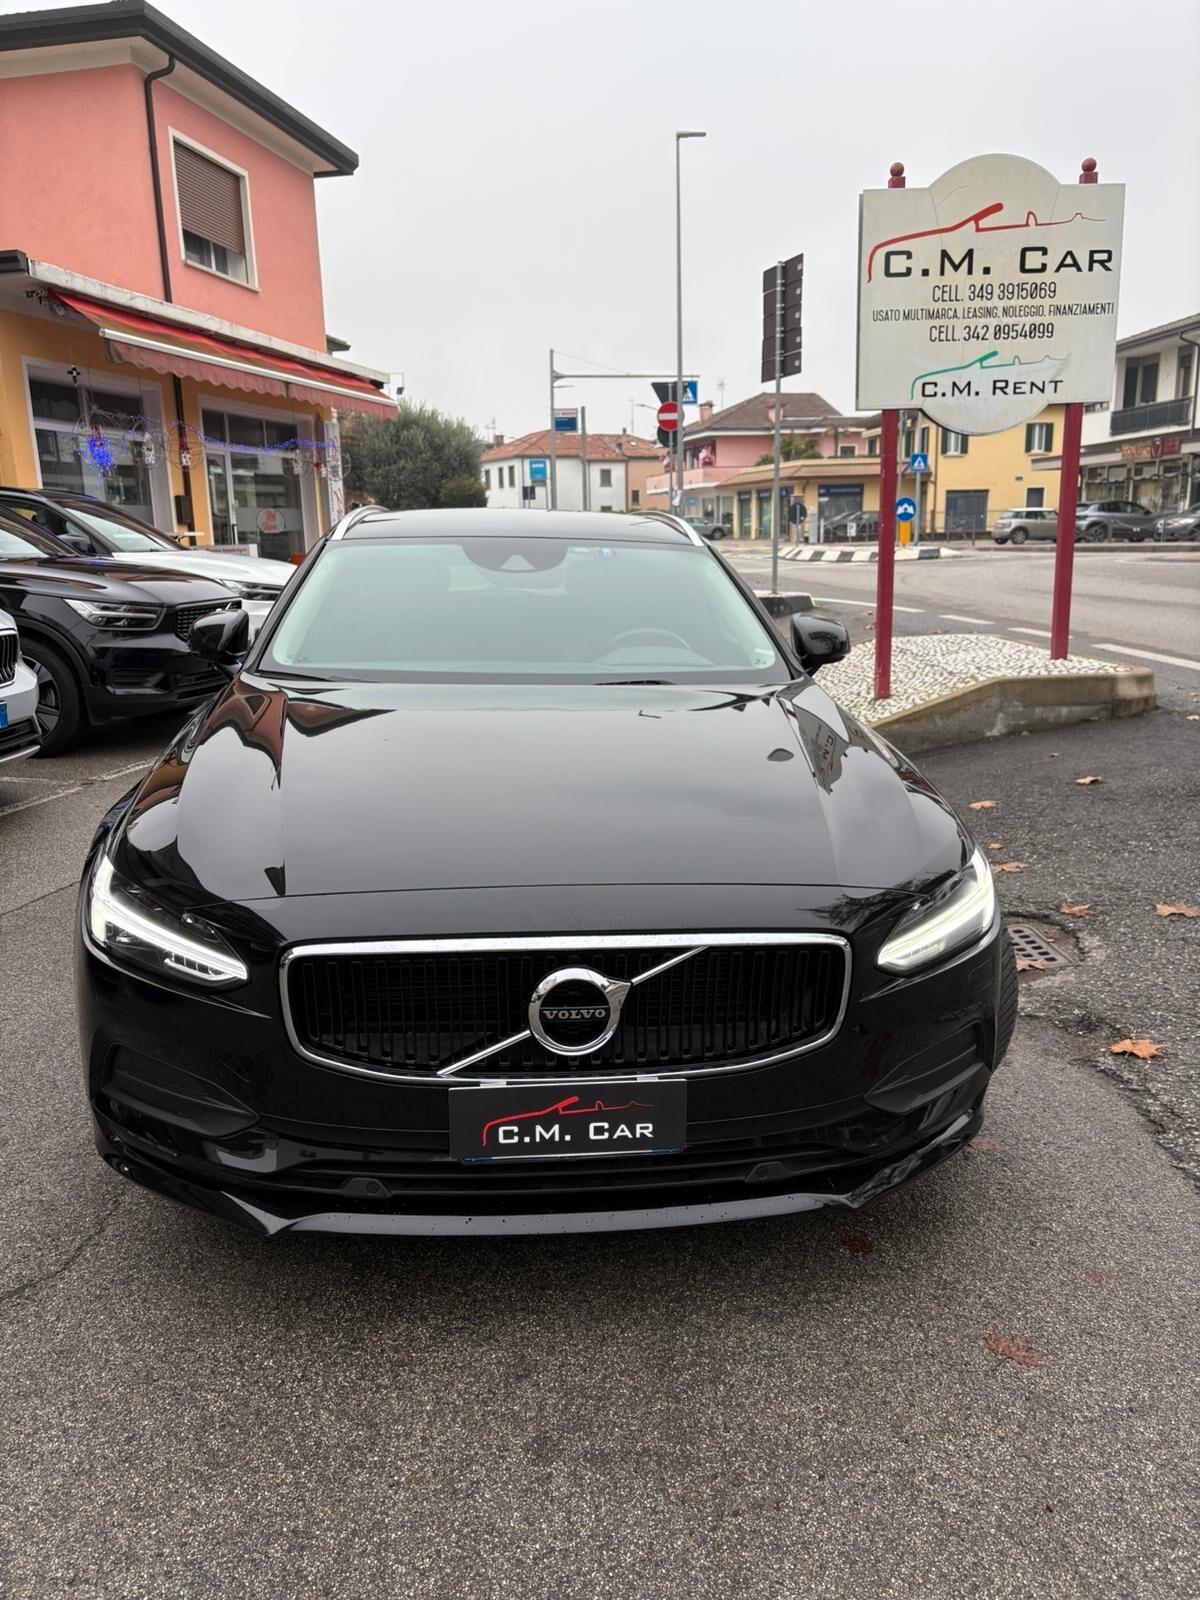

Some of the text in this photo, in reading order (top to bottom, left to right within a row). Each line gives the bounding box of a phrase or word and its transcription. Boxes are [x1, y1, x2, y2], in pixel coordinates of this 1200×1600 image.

[884, 248, 991, 277] C.M.
[932, 282, 1056, 302] CELL. 349 3915069
[872, 309, 900, 321] USATO
[1048, 302, 1114, 317] FINANZIAMENTI
[929, 322, 1054, 342] CELL. 342 0954099
[921, 380, 979, 398] C.M.
[542, 1009, 606, 1019] VOLVO
[498, 1124, 571, 1144] C.M.
